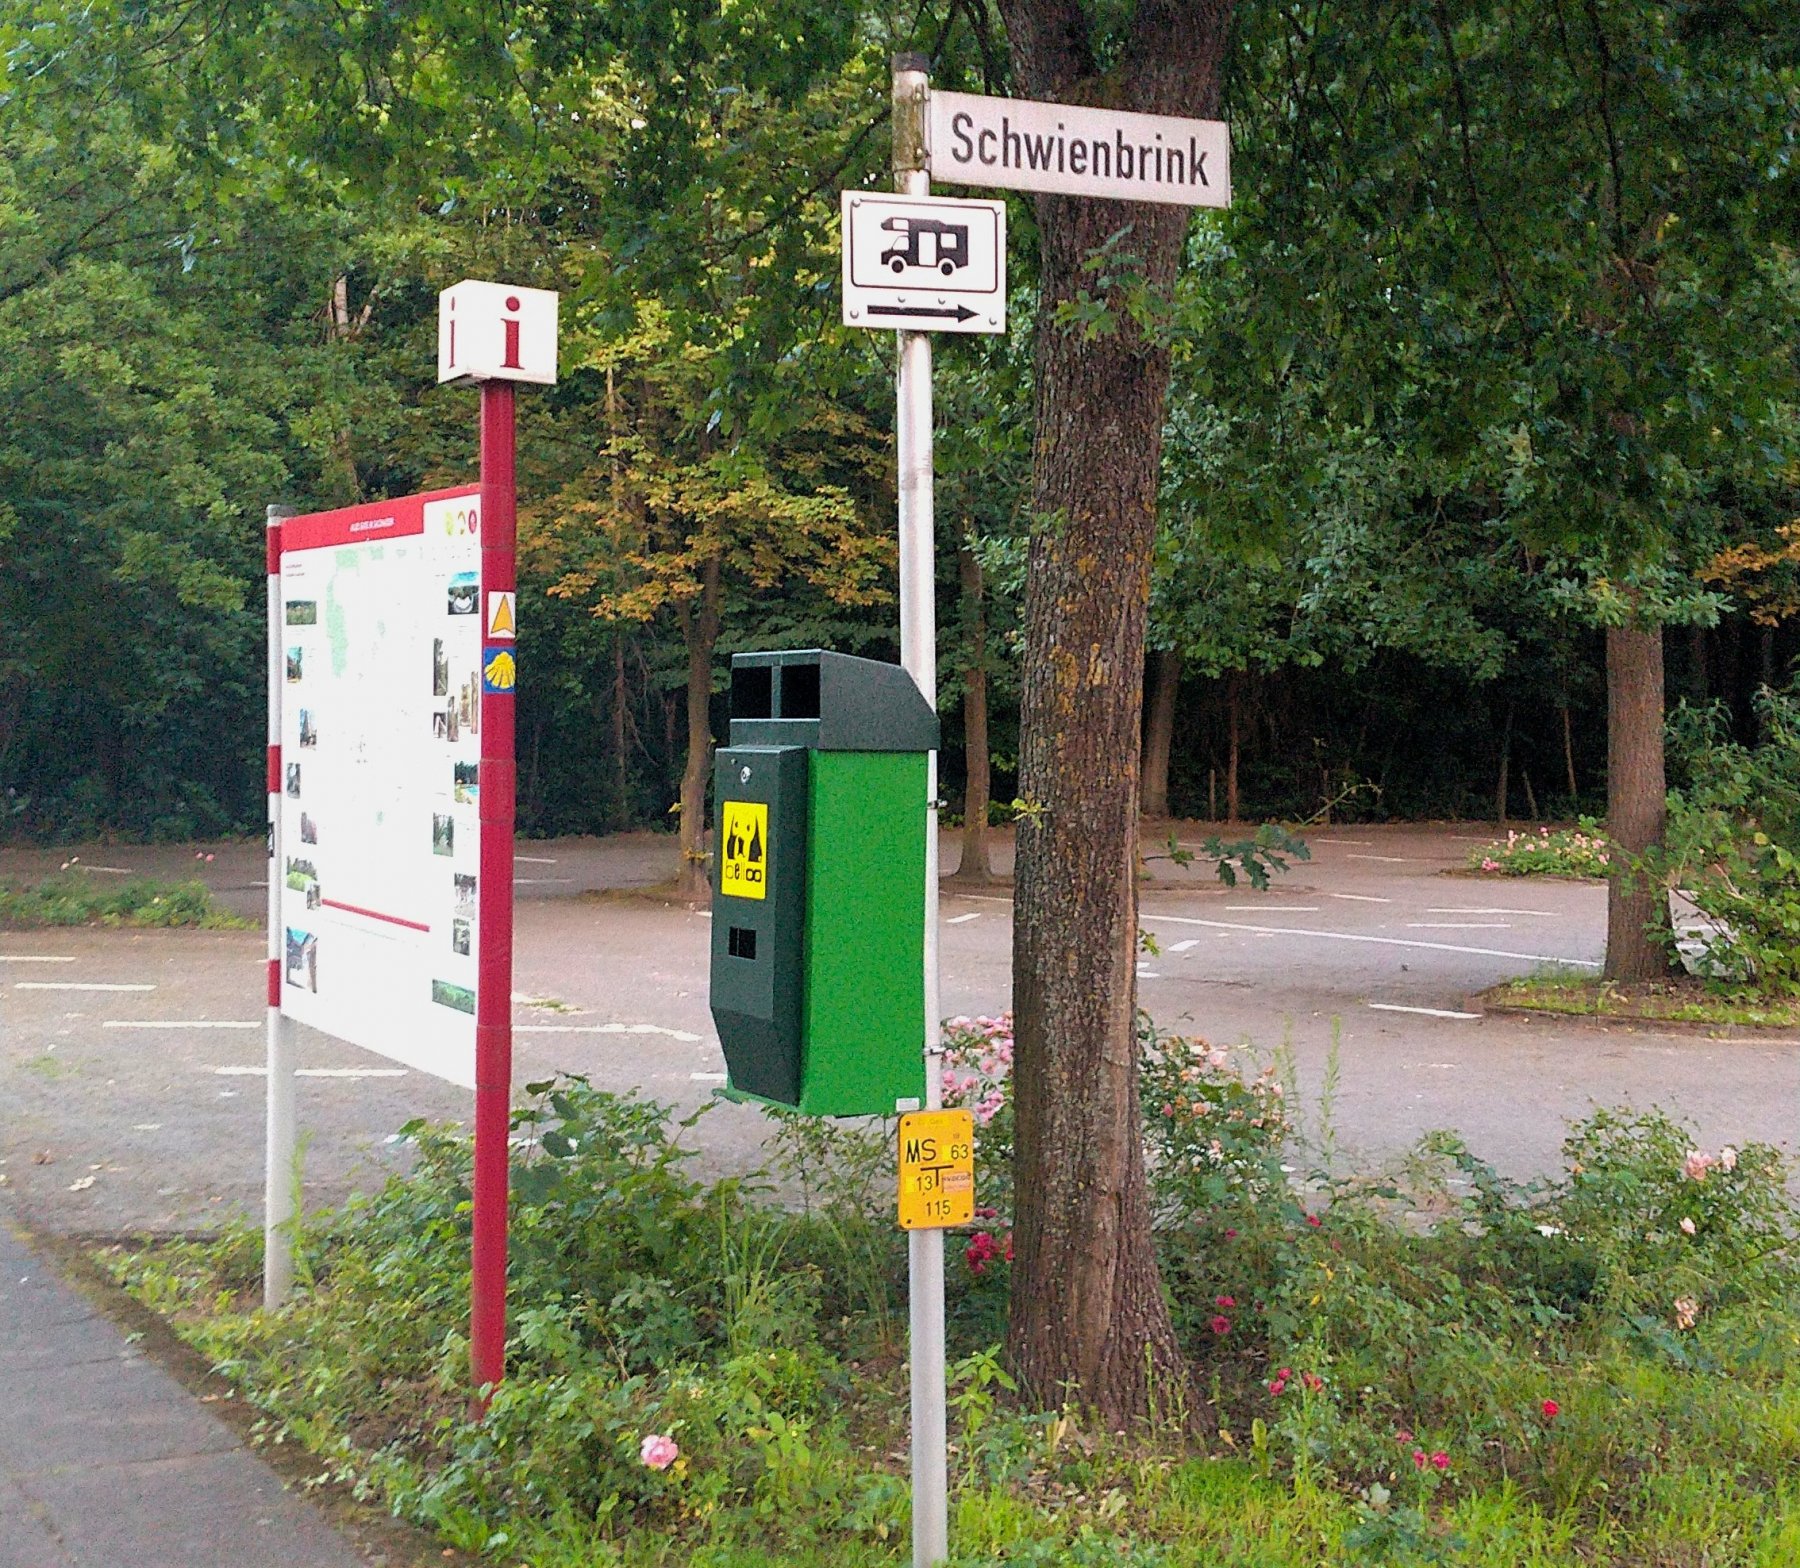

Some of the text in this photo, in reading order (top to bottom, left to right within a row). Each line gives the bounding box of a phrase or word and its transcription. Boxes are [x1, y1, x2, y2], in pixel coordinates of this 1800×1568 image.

[951, 111, 1209, 186] Schwienbrink
[500, 296, 525, 370] i
[906, 1138, 936, 1163] MS
[951, 1144, 969, 1160] 63
[916, 1176, 932, 1191] 13
[926, 1200, 951, 1216] 115
